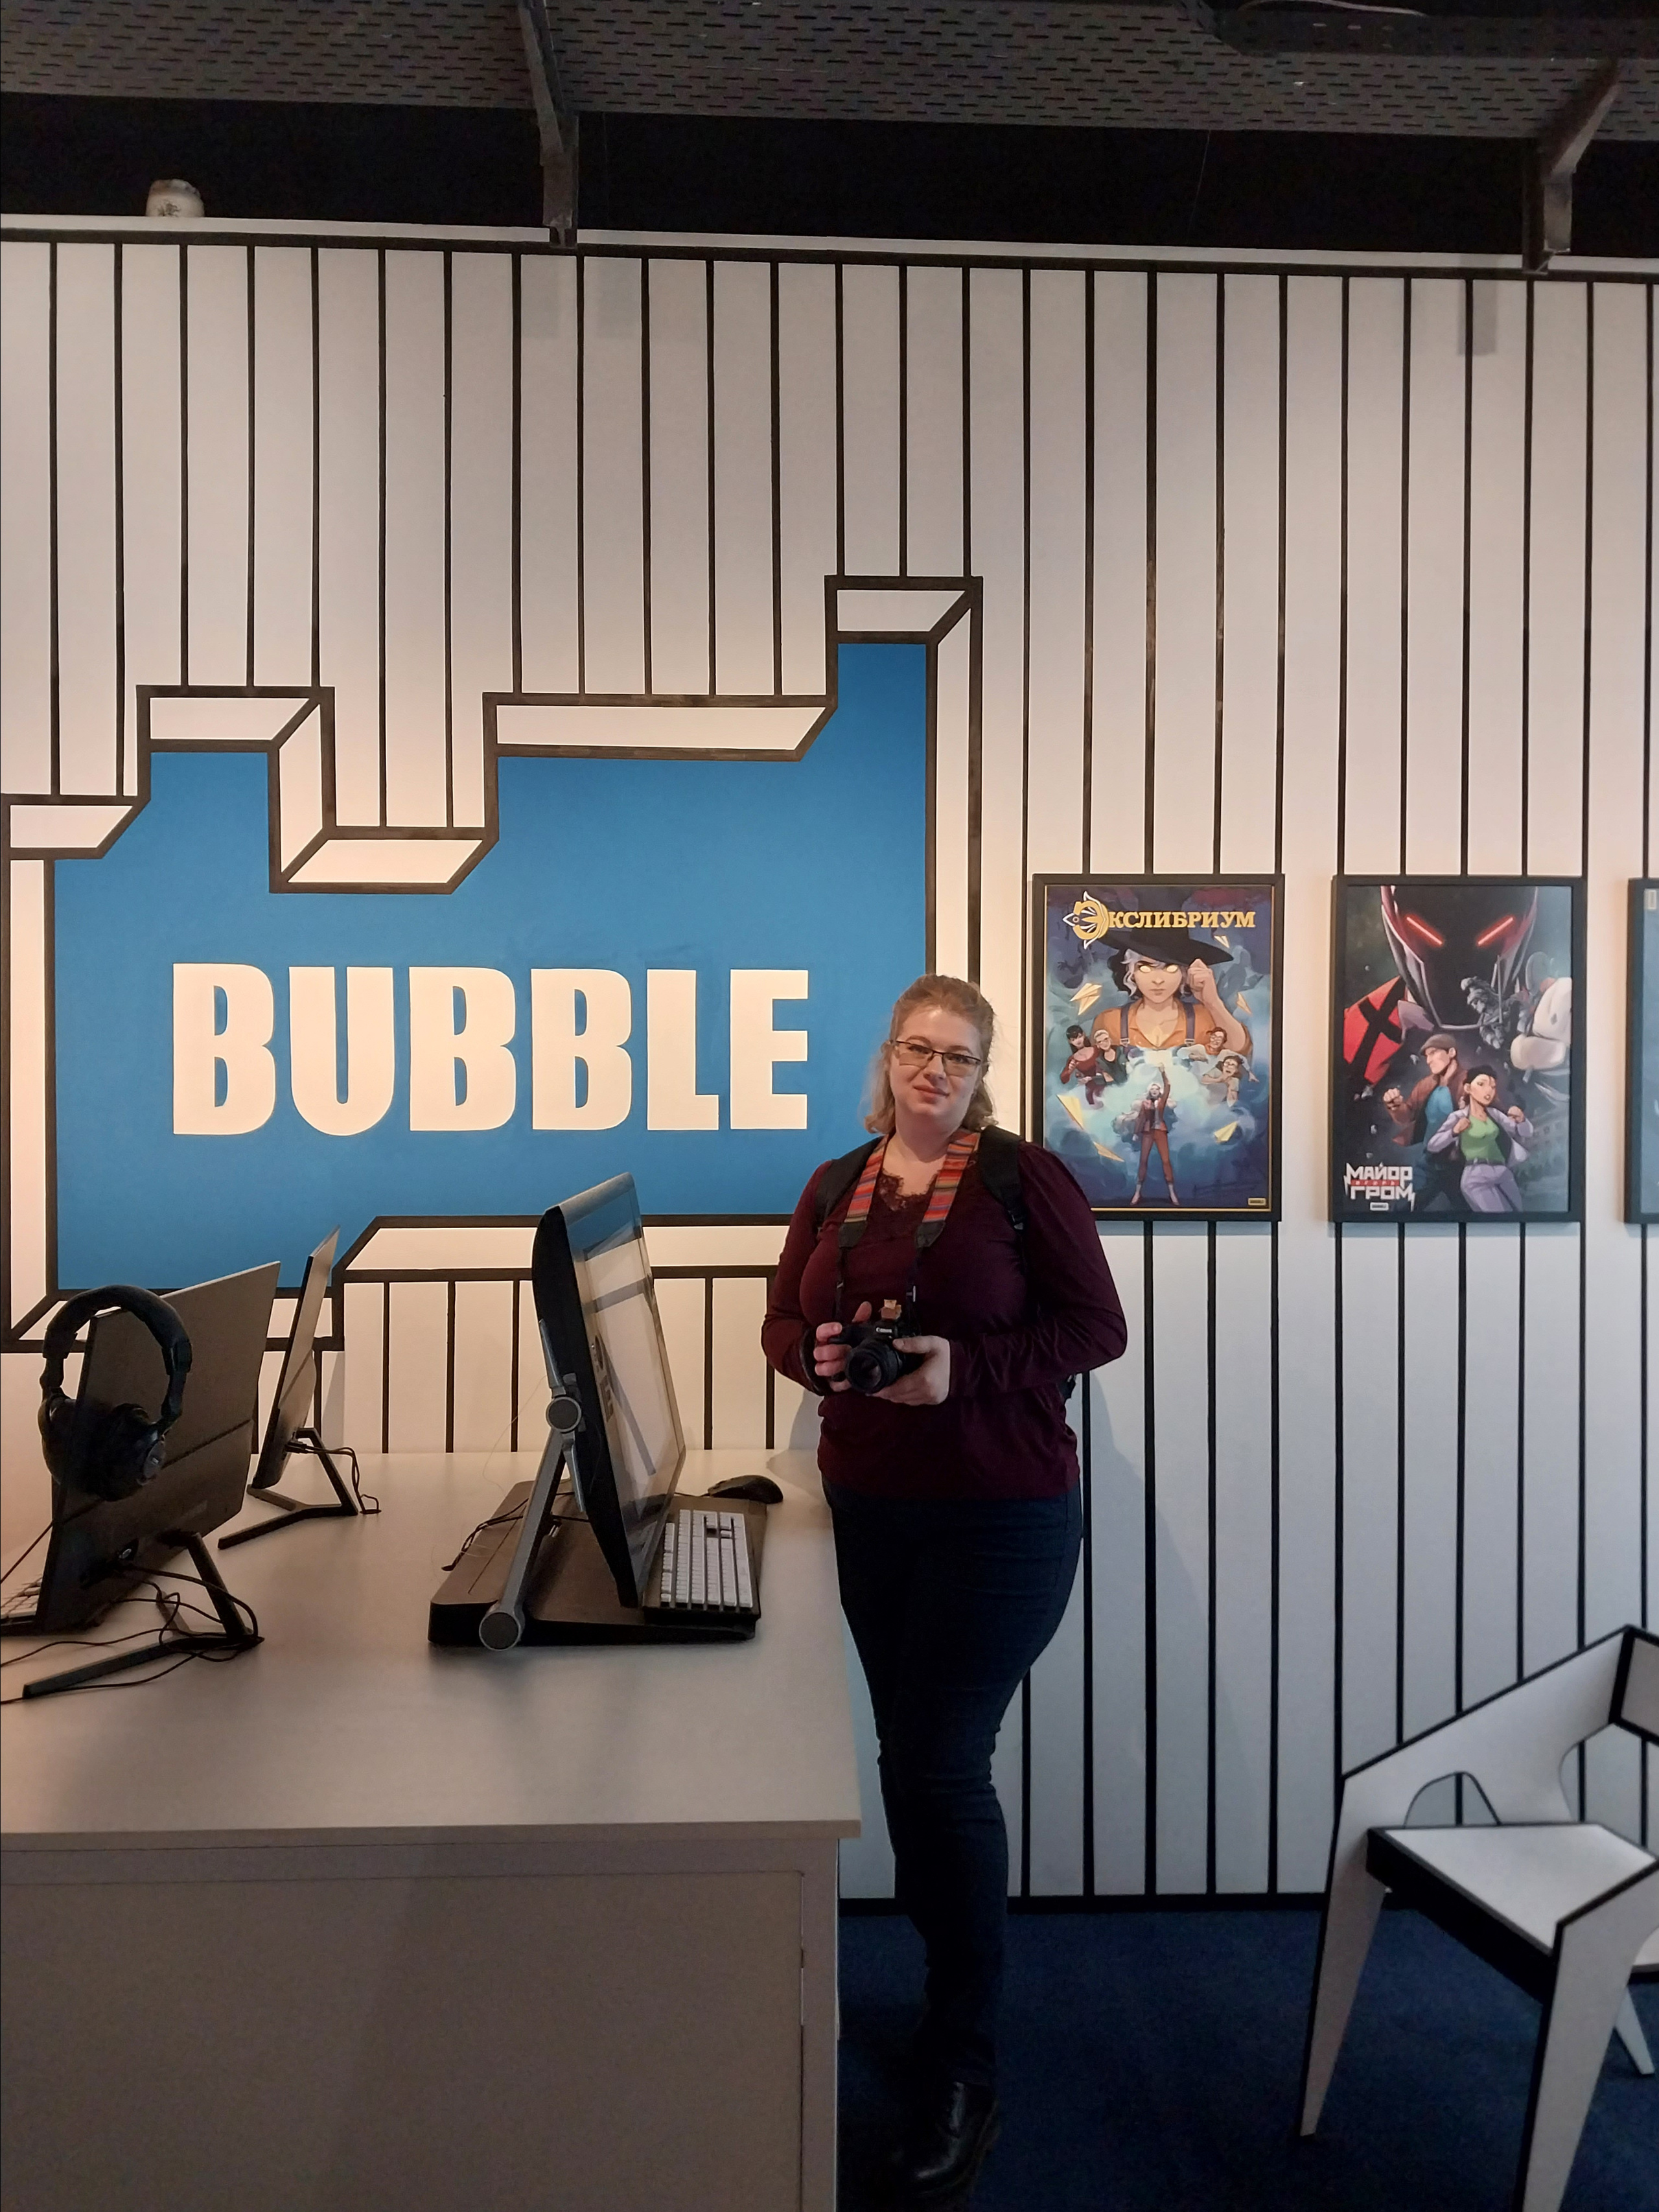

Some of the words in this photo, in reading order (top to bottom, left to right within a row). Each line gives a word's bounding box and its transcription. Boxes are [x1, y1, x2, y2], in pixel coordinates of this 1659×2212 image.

[1073, 900, 1255, 940] ЭКСЛИБРИУМ
[172, 962, 809, 1135] BUBBLE
[1343, 1162, 1413, 1189] МАЙОР
[1350, 1183, 1415, 1205] ГРОМ
